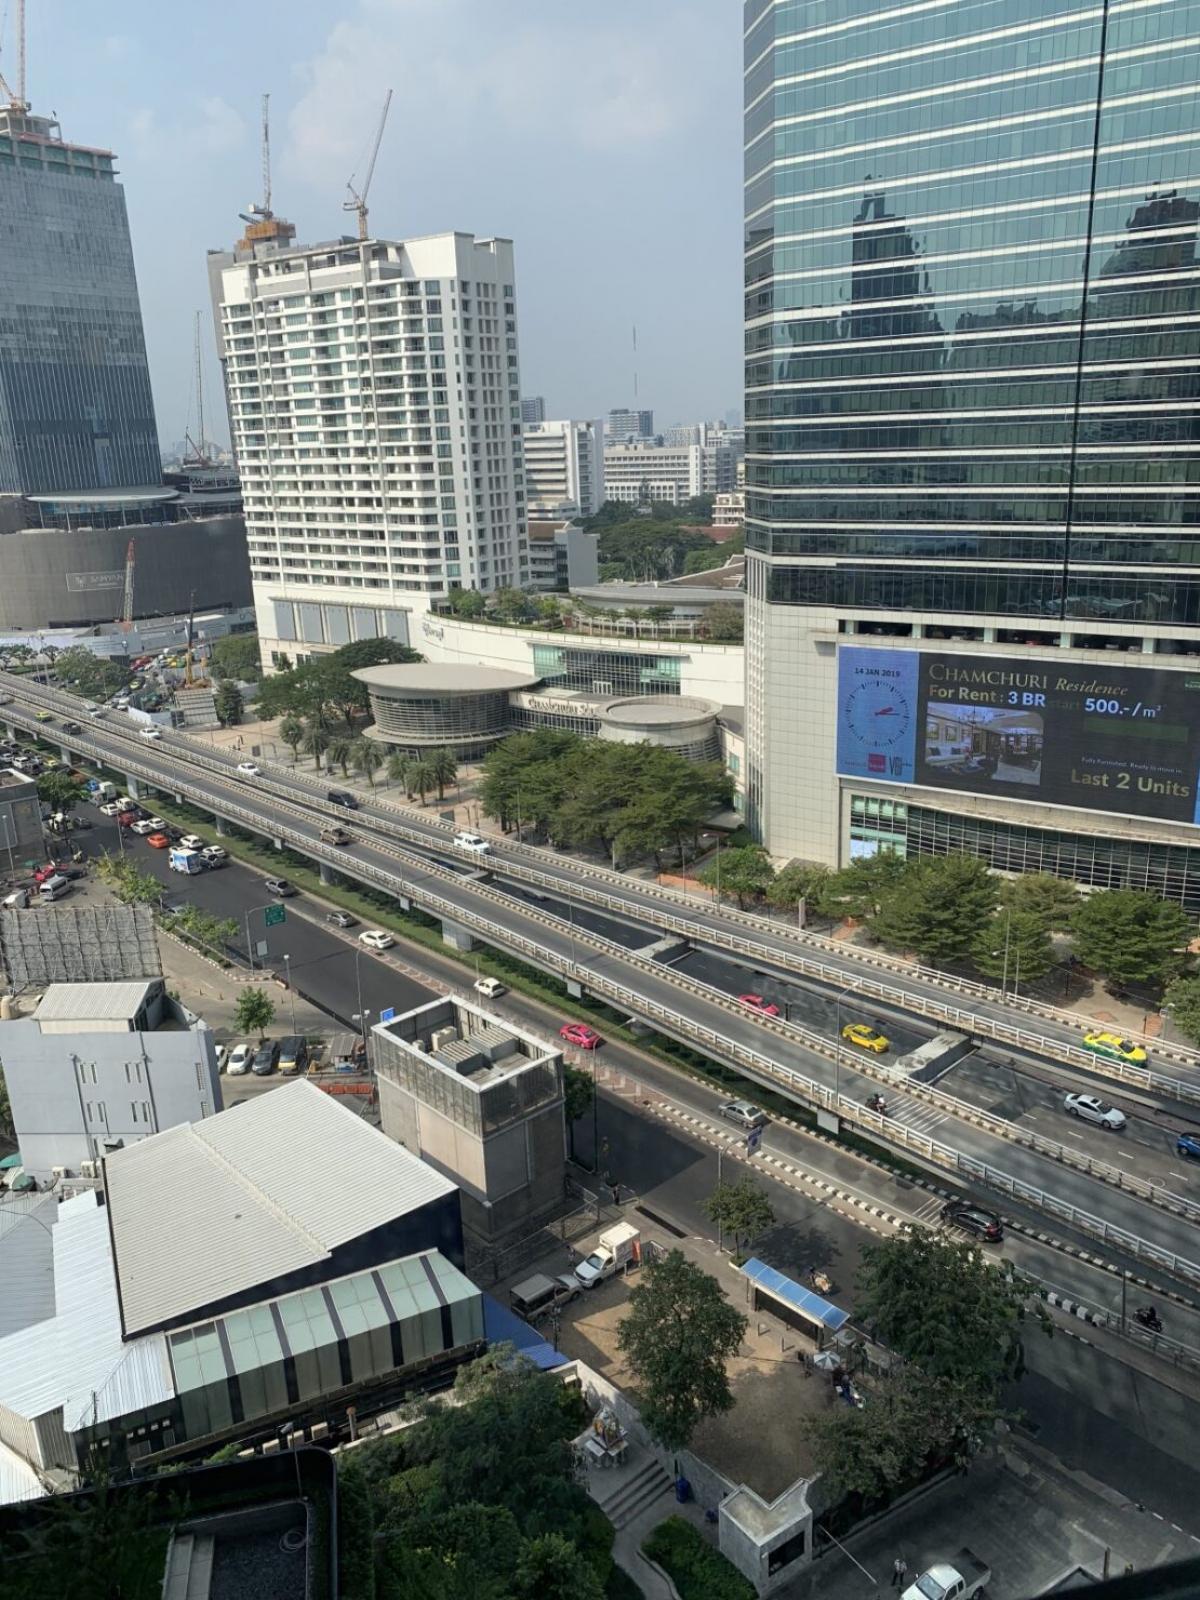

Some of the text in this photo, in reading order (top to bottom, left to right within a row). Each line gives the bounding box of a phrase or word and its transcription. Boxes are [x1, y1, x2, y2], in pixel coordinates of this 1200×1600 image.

[855, 667, 901, 678] 14 JAN 2019
[929, 684, 955, 699] For
[1007, 691, 1019, 705] 3
[1022, 692, 1046, 708] BR
[1055, 678, 1129, 696] Residence
[1071, 768, 1191, 798] Last 2 Units
